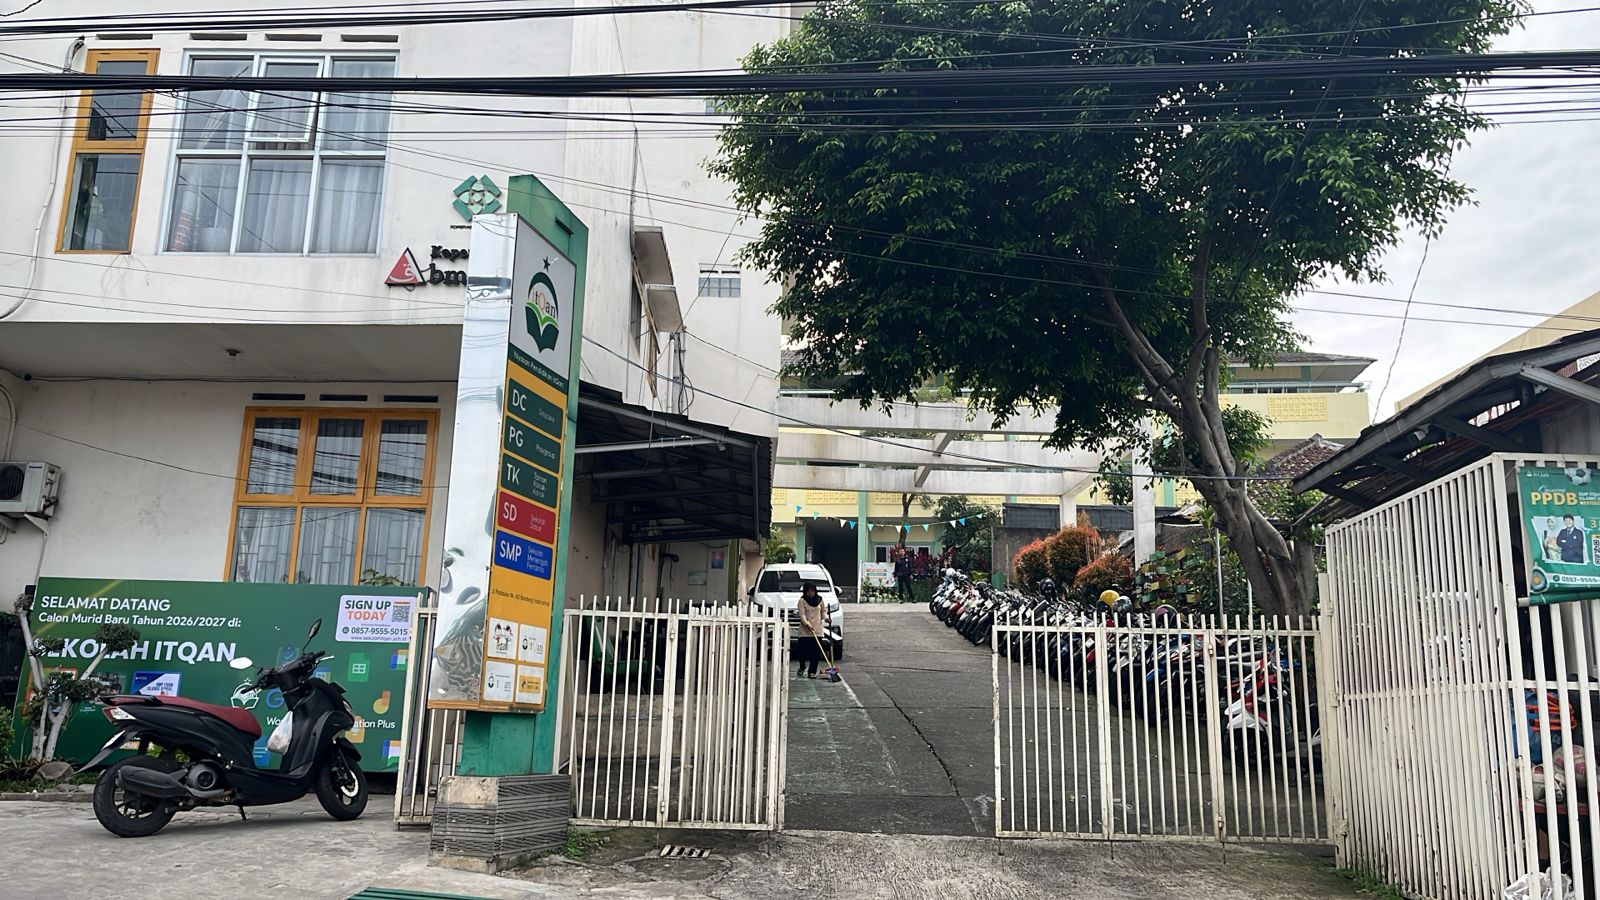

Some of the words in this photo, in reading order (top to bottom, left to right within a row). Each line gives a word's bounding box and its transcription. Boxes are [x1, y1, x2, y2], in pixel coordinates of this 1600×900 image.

[430, 245, 470, 262] Kope
[512, 390, 527, 411] DC
[509, 426, 524, 448] PG
[506, 463, 521, 486] TK
[1531, 491, 1578, 506] PPDB
[503, 502, 517, 522] SD
[499, 540, 522, 562] SMP
[41, 596, 108, 610] SELAMAT
[110, 598, 171, 612] DATANG
[345, 600, 373, 610] SIGN
[375, 601, 391, 611] UP
[39, 612, 69, 623] Calon
[71, 613, 101, 624] Murid
[104, 614, 130, 625] Baru
[132, 615, 164, 626] Tahun
[166, 616, 226, 628] 2026/2027
[227, 617, 242, 628] di:
[347, 610, 387, 621] TODAY
[351, 627, 408, 635] 0857-9555-5015
[153, 640, 237, 665] ITQAN
[377, 719, 396, 729] Plus
